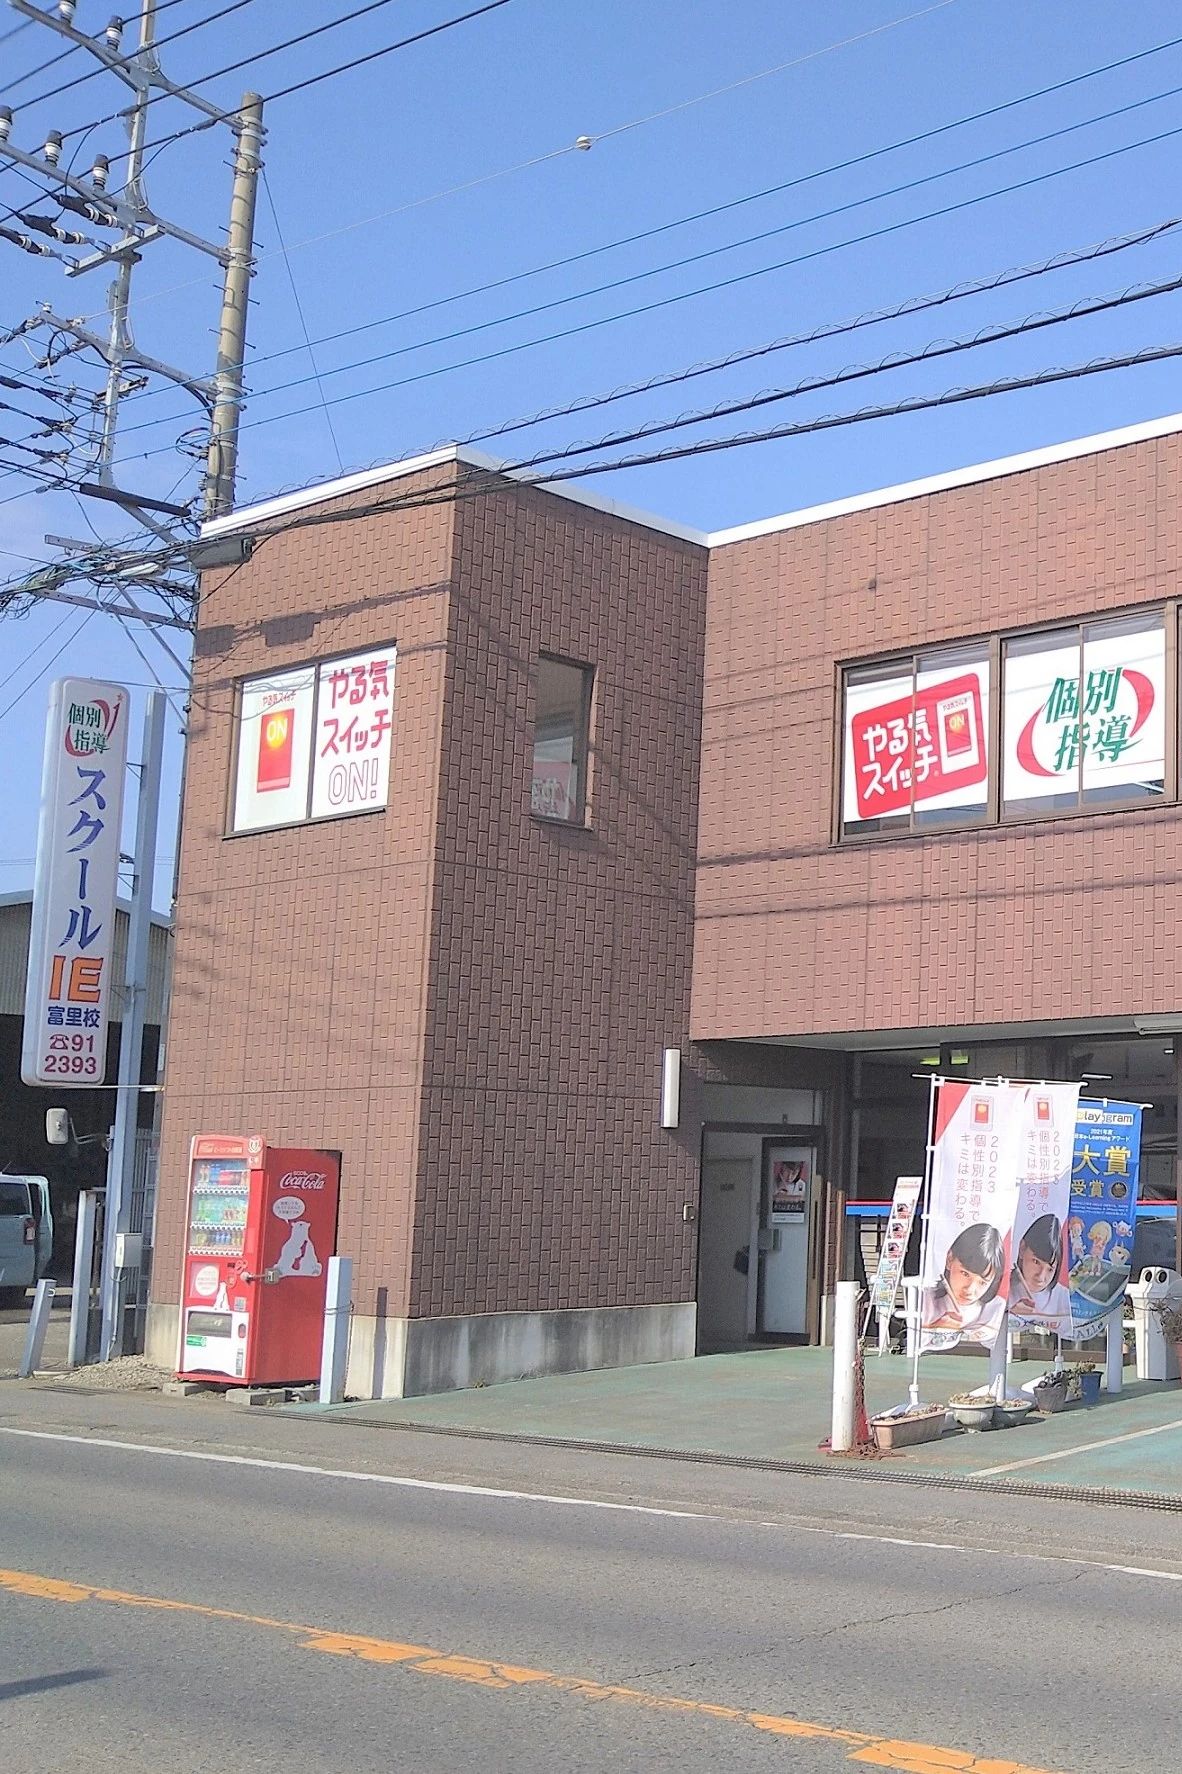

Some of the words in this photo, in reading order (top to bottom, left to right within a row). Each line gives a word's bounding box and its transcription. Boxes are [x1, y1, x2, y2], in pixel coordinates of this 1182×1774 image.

[328, 660, 390, 709] やる気
[1045, 666, 1124, 725] 個別
[68, 702, 102, 729] 個別
[266, 717, 288, 742] ON
[321, 709, 391, 758] スイッチ
[862, 708, 933, 762] やる気
[74, 729, 110, 754] 指導
[1053, 714, 1144, 773] 指導
[328, 758, 379, 806] ON!
[862, 745, 939, 800] スイッチ
[57, 766, 107, 950] スクール
[48, 955, 104, 1004] IE
[47, 1006, 101, 1029] 富里校
[44, 1054, 97, 1075] 2393
[71, 1033, 95, 1053] 91
[969, 1134, 987, 1221] 個性別指導で
[987, 1135, 999, 1193] 2023
[1072, 1144, 1132, 1177] 大賞
[1071, 1179, 1105, 1198] 受賞
